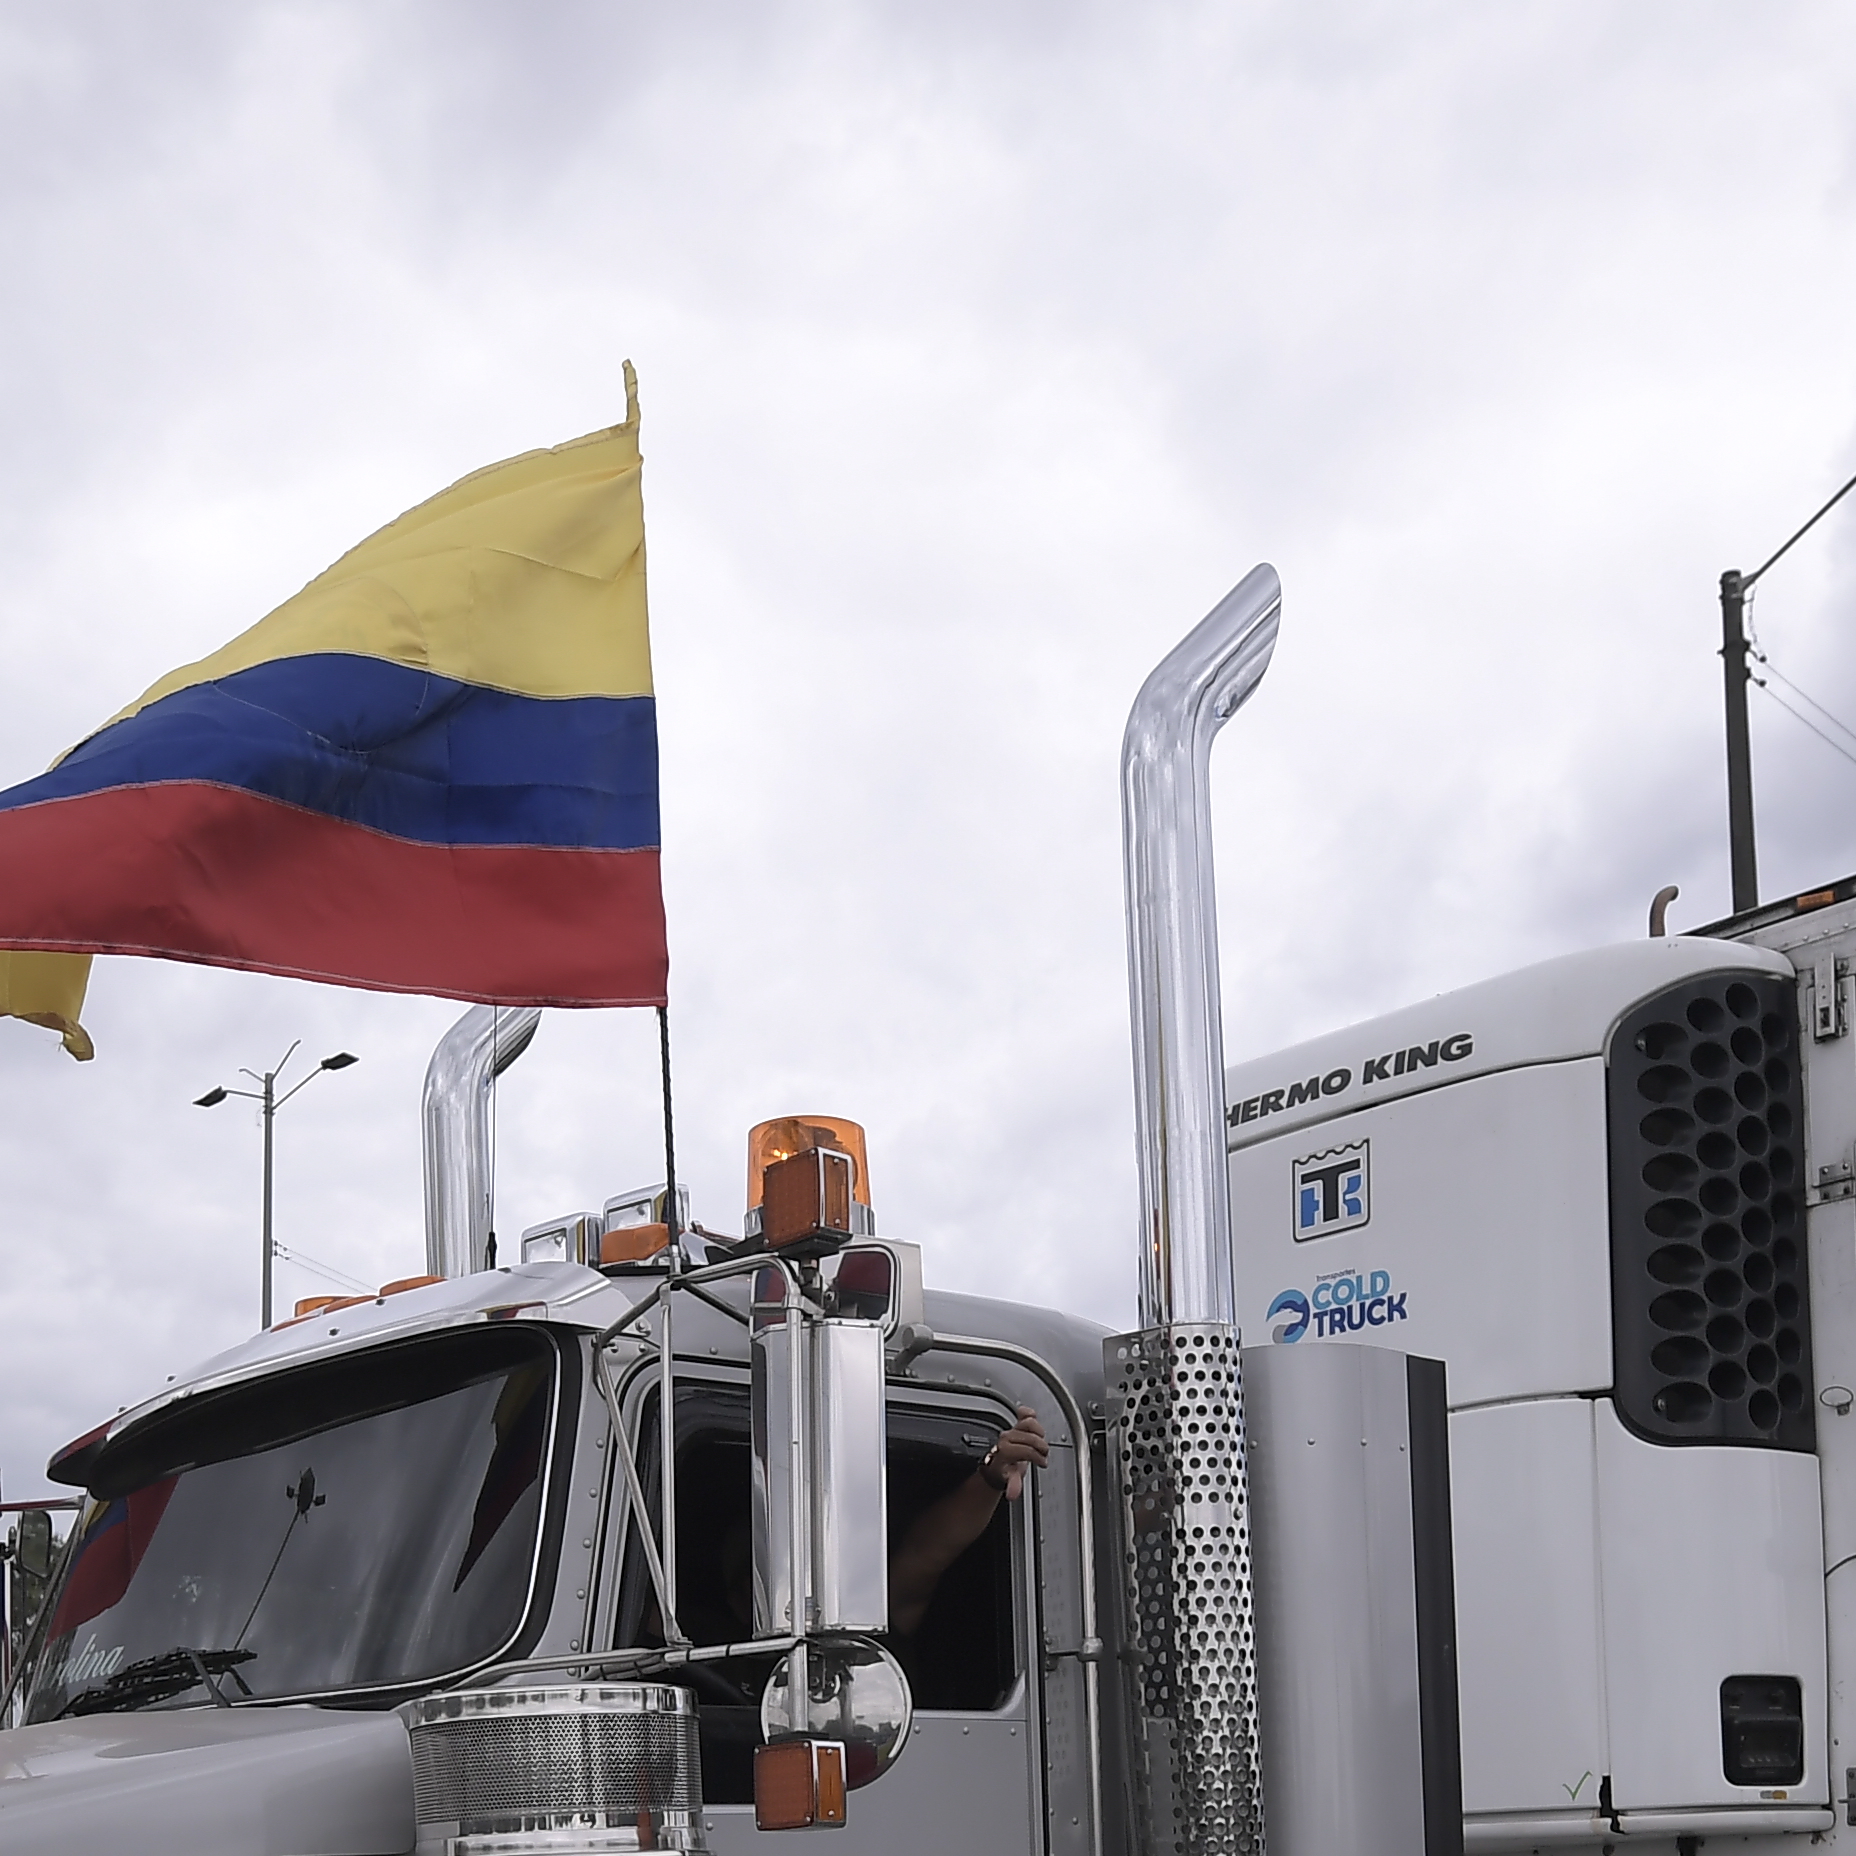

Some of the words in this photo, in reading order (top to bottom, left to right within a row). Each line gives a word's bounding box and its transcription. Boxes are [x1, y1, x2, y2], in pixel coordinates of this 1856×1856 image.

[1226, 1067, 1352, 1128] HERMO
[1362, 1033, 1474, 1085] KING
[1311, 1269, 1391, 1310] COLD
[1312, 1292, 1408, 1338] TRUCK
